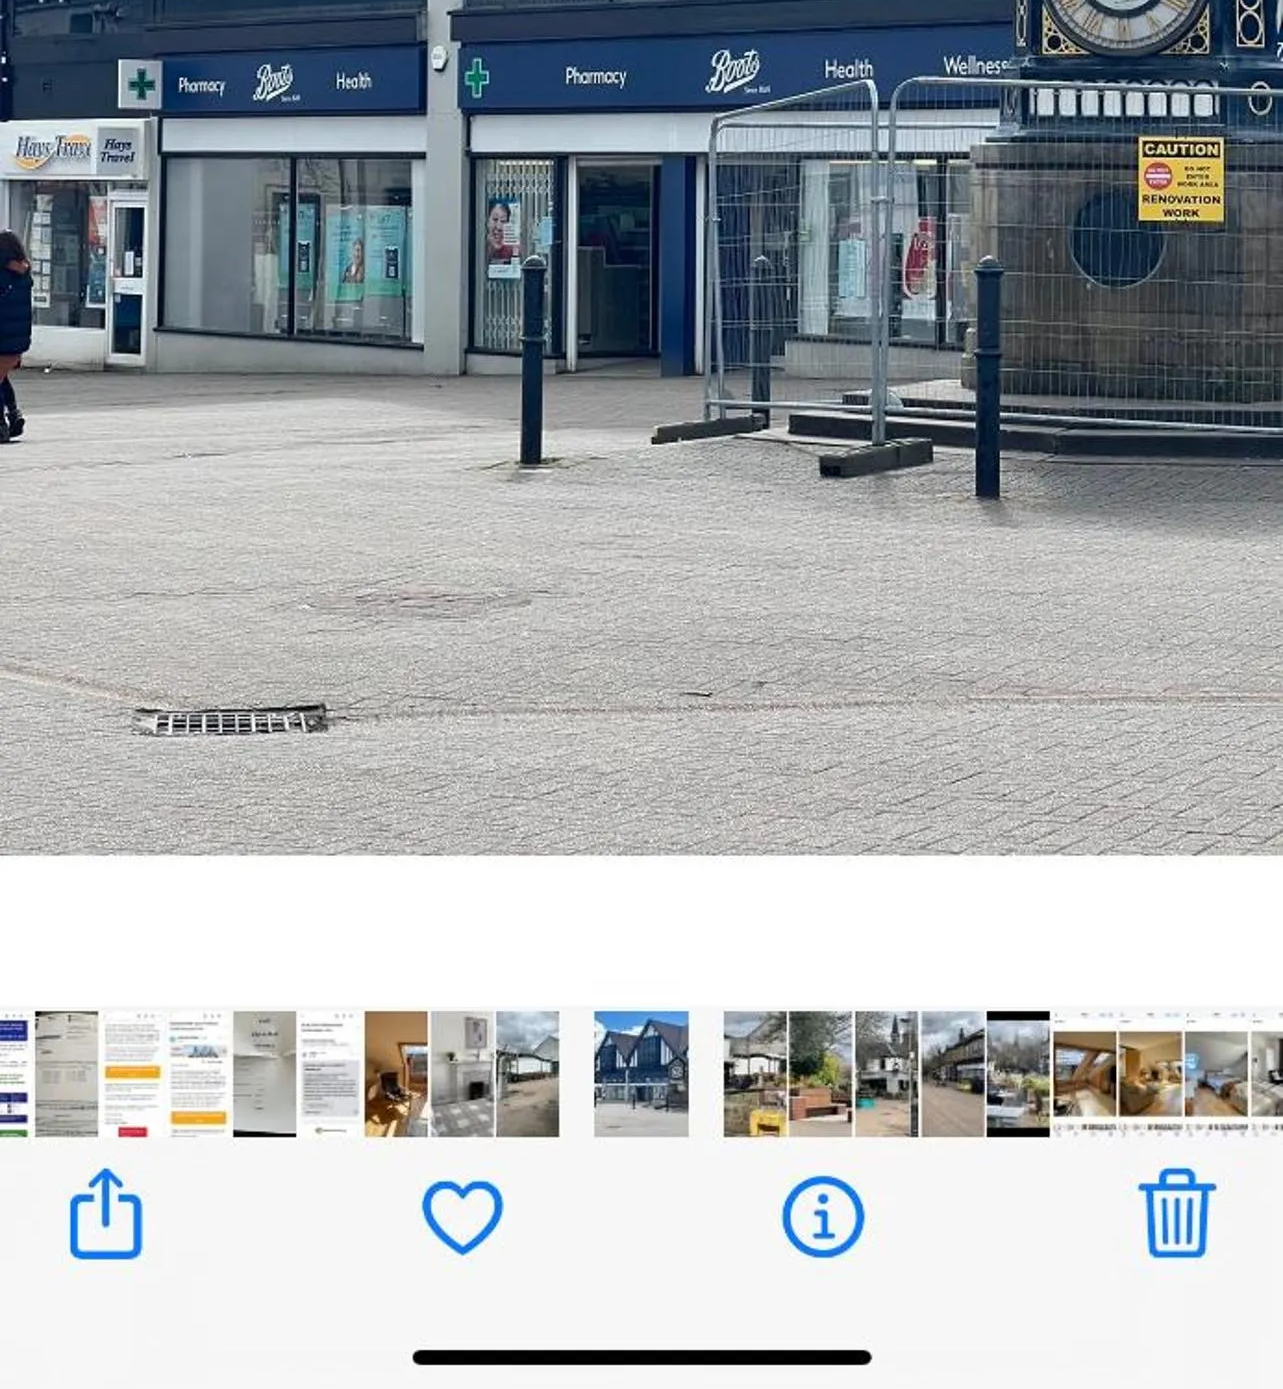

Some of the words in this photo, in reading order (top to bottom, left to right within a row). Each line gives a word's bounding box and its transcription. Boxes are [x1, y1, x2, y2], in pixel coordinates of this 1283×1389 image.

[565, 66, 627, 90] Pharmacy
[704, 49, 760, 93] Boots
[825, 59, 874, 79] Health
[178, 76, 226, 98] Pharmacy
[253, 63, 293, 101] Boots
[336, 71, 372, 90] Health
[104, 138, 132, 150] Hays
[1144, 143, 1219, 156] CAUTION
[101, 152, 136, 163] Travel
[1142, 194, 1220, 204] RENOVATION
[1163, 209, 1200, 218] WORK
